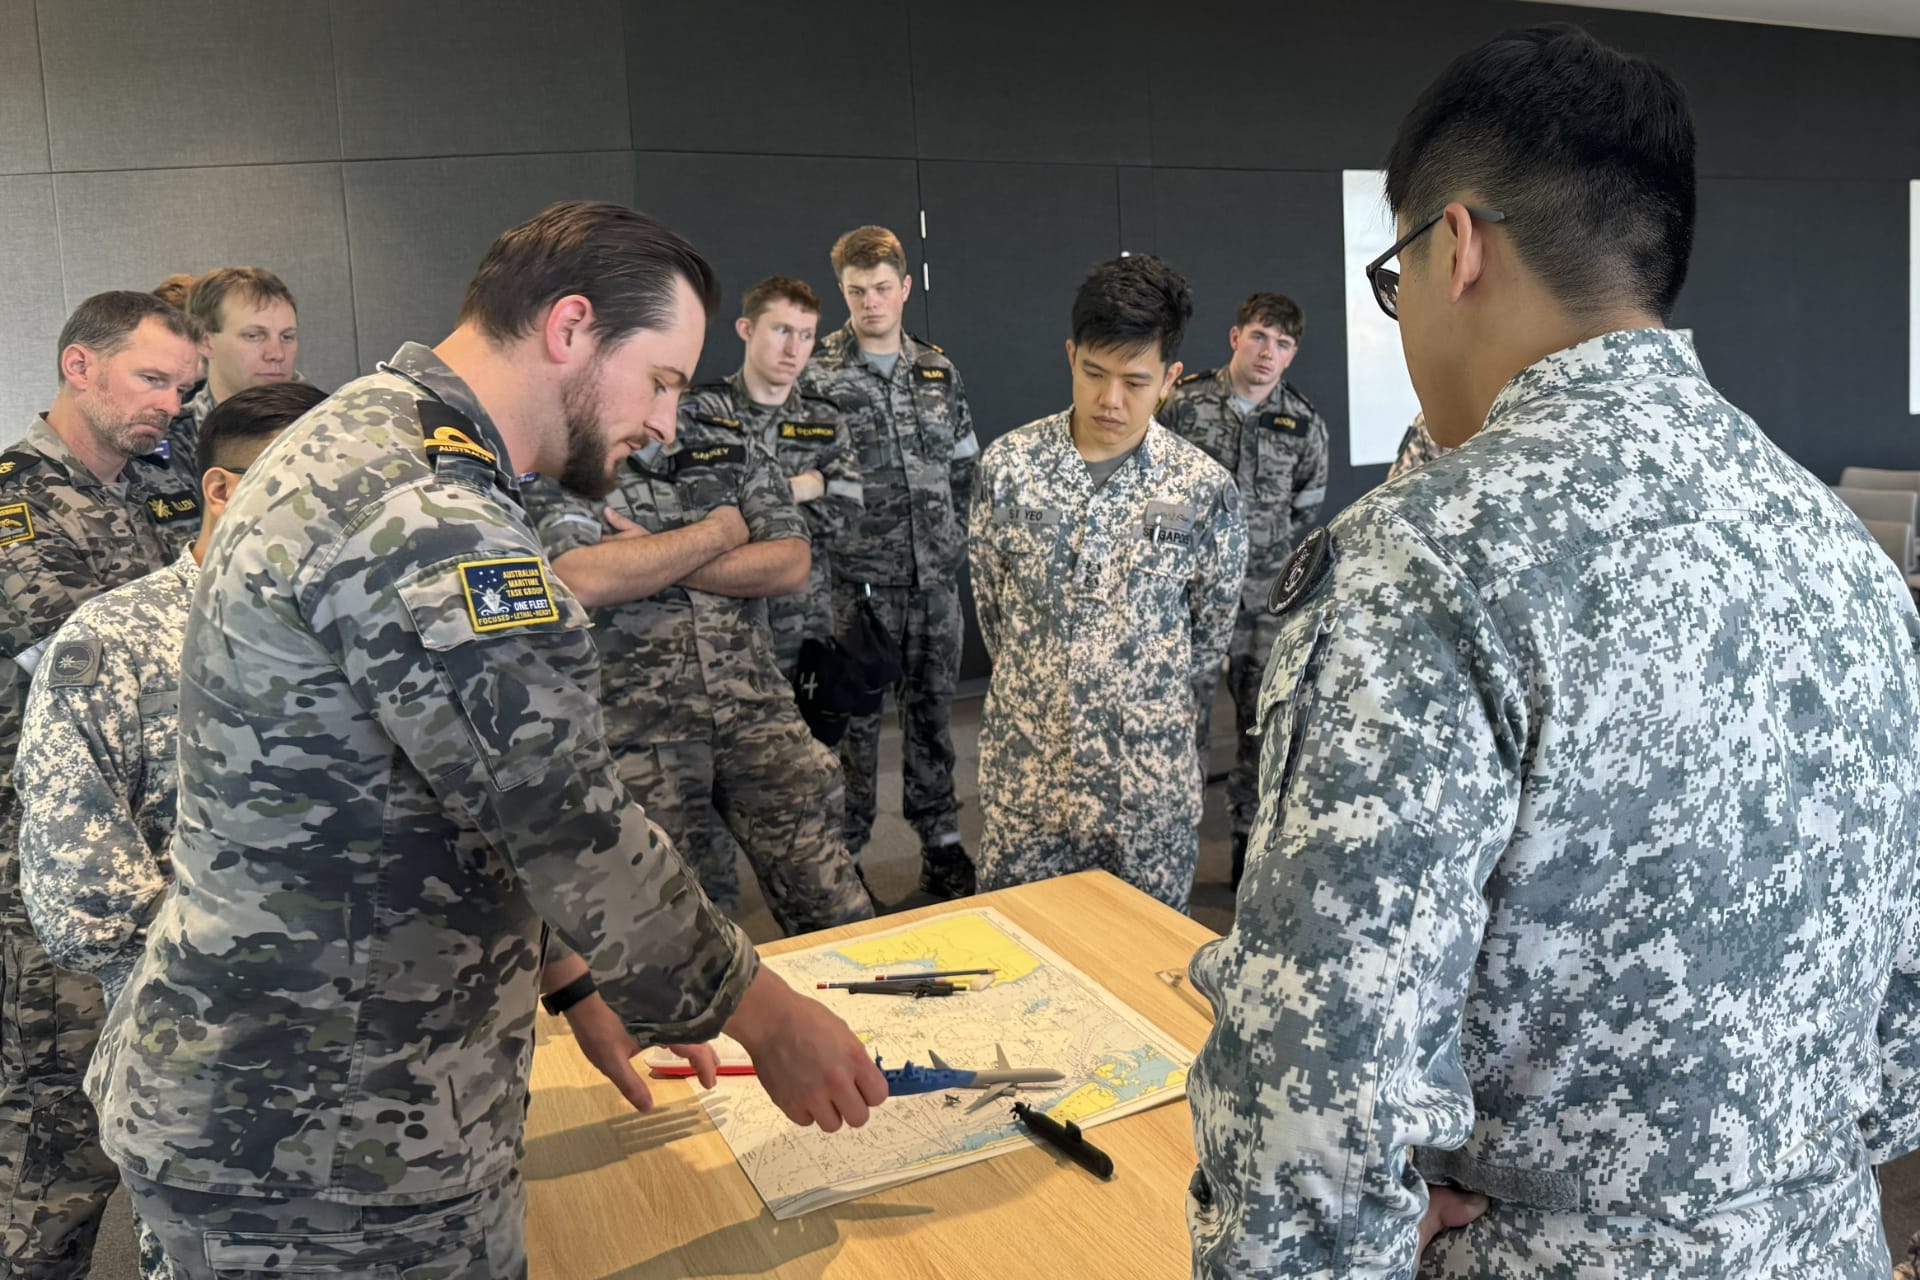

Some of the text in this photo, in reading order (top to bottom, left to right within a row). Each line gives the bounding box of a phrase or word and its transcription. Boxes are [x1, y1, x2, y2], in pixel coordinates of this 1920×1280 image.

[1025, 509, 1043, 521] YEO
[503, 569, 539, 578] AUSTRALIAN
[508, 578, 539, 588] MARITIME
[506, 587, 544, 598] TASK GROUP
[514, 599, 548, 611] ONE FLEET
[478, 614, 511, 626] FOCUSED
[514, 611, 533, 620] LETHAL
